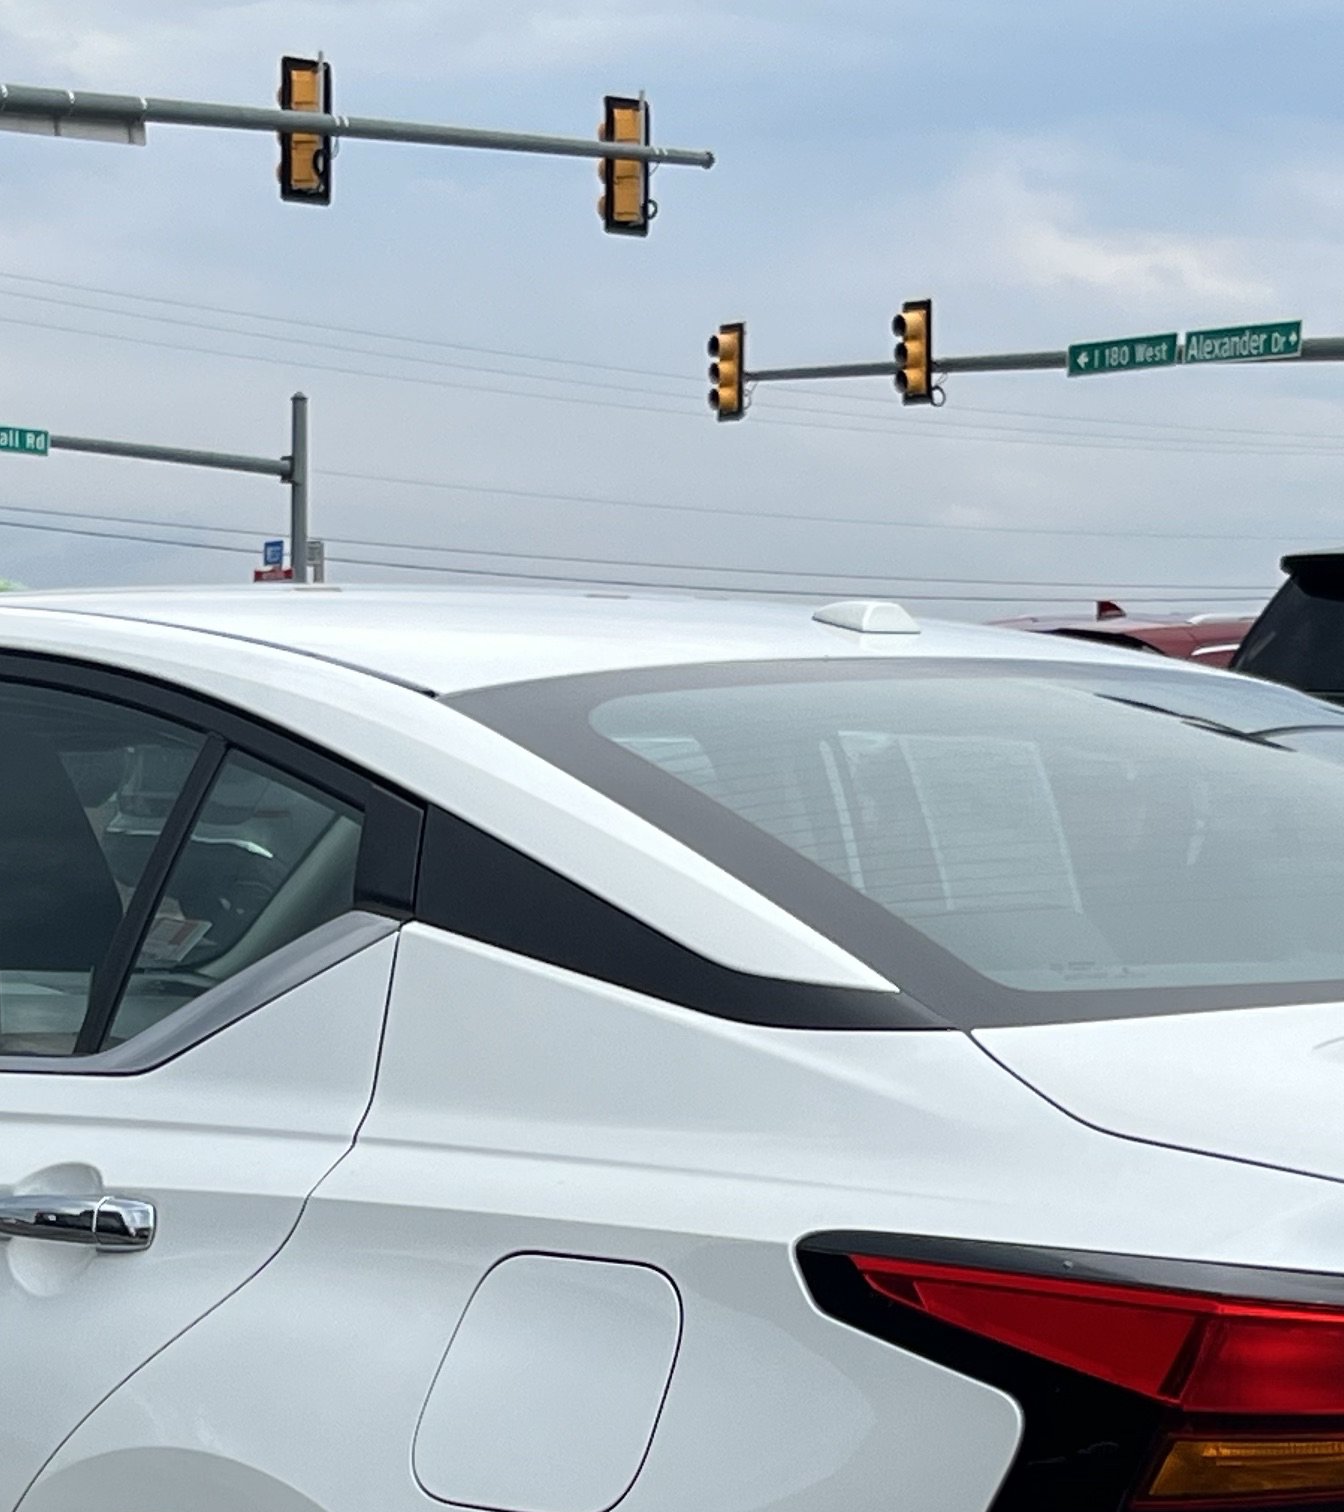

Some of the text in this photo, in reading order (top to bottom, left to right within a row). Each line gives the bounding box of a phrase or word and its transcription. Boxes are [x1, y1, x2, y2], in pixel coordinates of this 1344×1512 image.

[1105, 345, 1129, 367] 180
[1134, 342, 1168, 363] West
[1187, 330, 1286, 361] Alexander Dr
[25, 432, 45, 450] Rd
